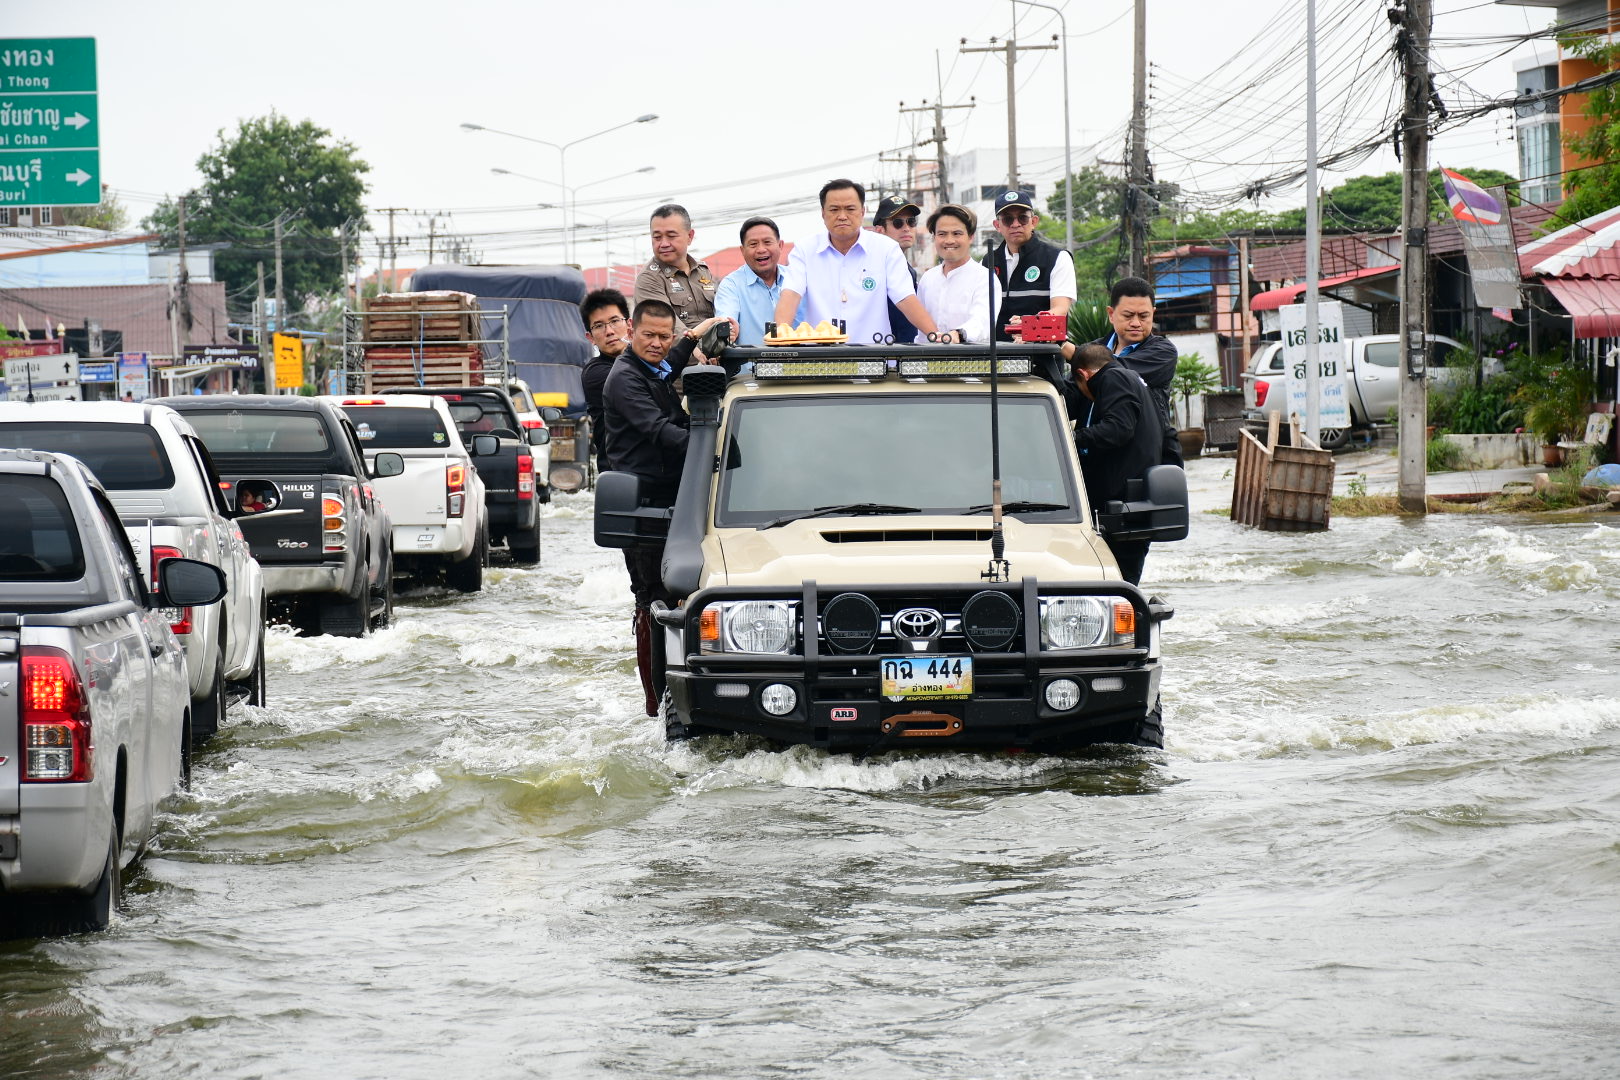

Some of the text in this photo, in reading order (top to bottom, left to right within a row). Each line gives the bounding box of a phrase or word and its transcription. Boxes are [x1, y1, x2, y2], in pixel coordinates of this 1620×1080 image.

[8, 75, 49, 90] Thong
[15, 133, 48, 146] Chan
[1294, 361, 1338, 380] สย
[282, 484, 315, 492] HILUX
[277, 541, 309, 549] VIGO
[884, 659, 963, 680] กฉ 444
[911, 683, 943, 693] อ่างทอง
[834, 710, 855, 719] ARB
